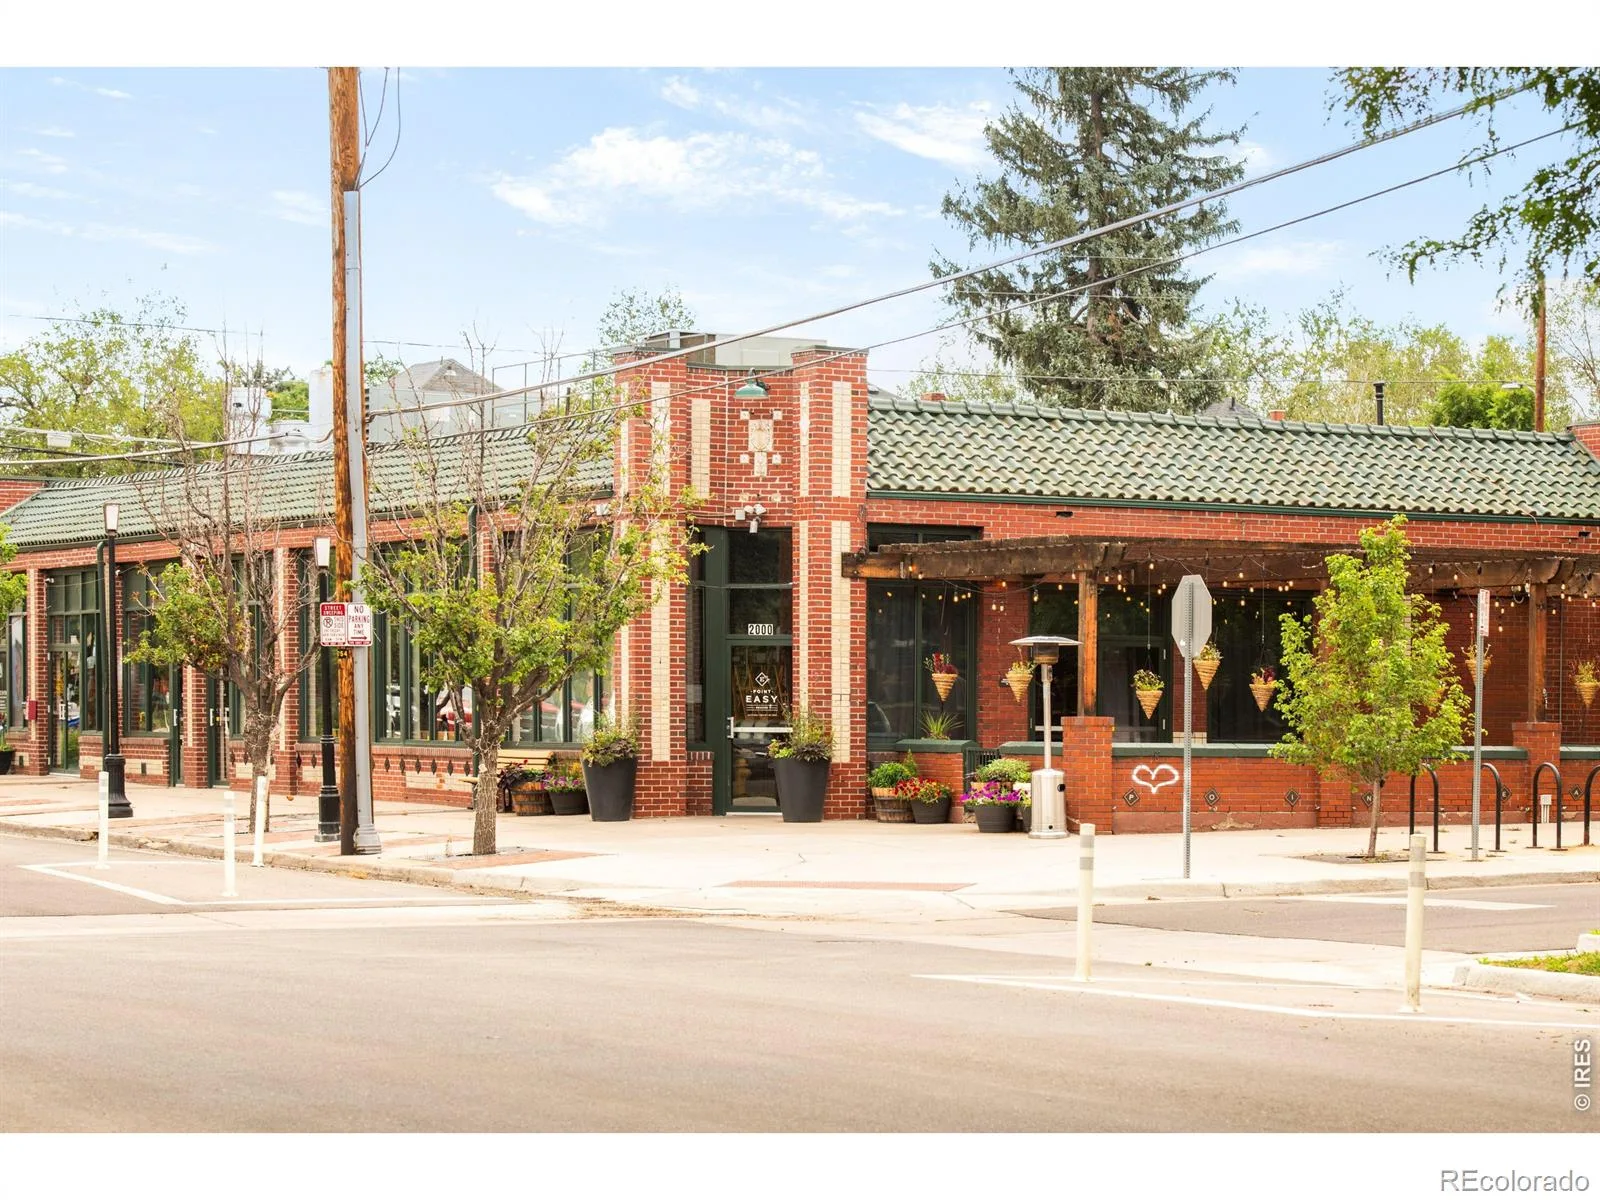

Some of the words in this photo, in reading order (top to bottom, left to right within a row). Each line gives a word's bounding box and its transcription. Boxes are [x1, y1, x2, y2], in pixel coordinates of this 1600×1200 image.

[354, 605, 364, 613] NO
[348, 615, 370, 623] PARKING
[749, 624, 773, 635] 2000
[745, 695, 778, 703] EASY
